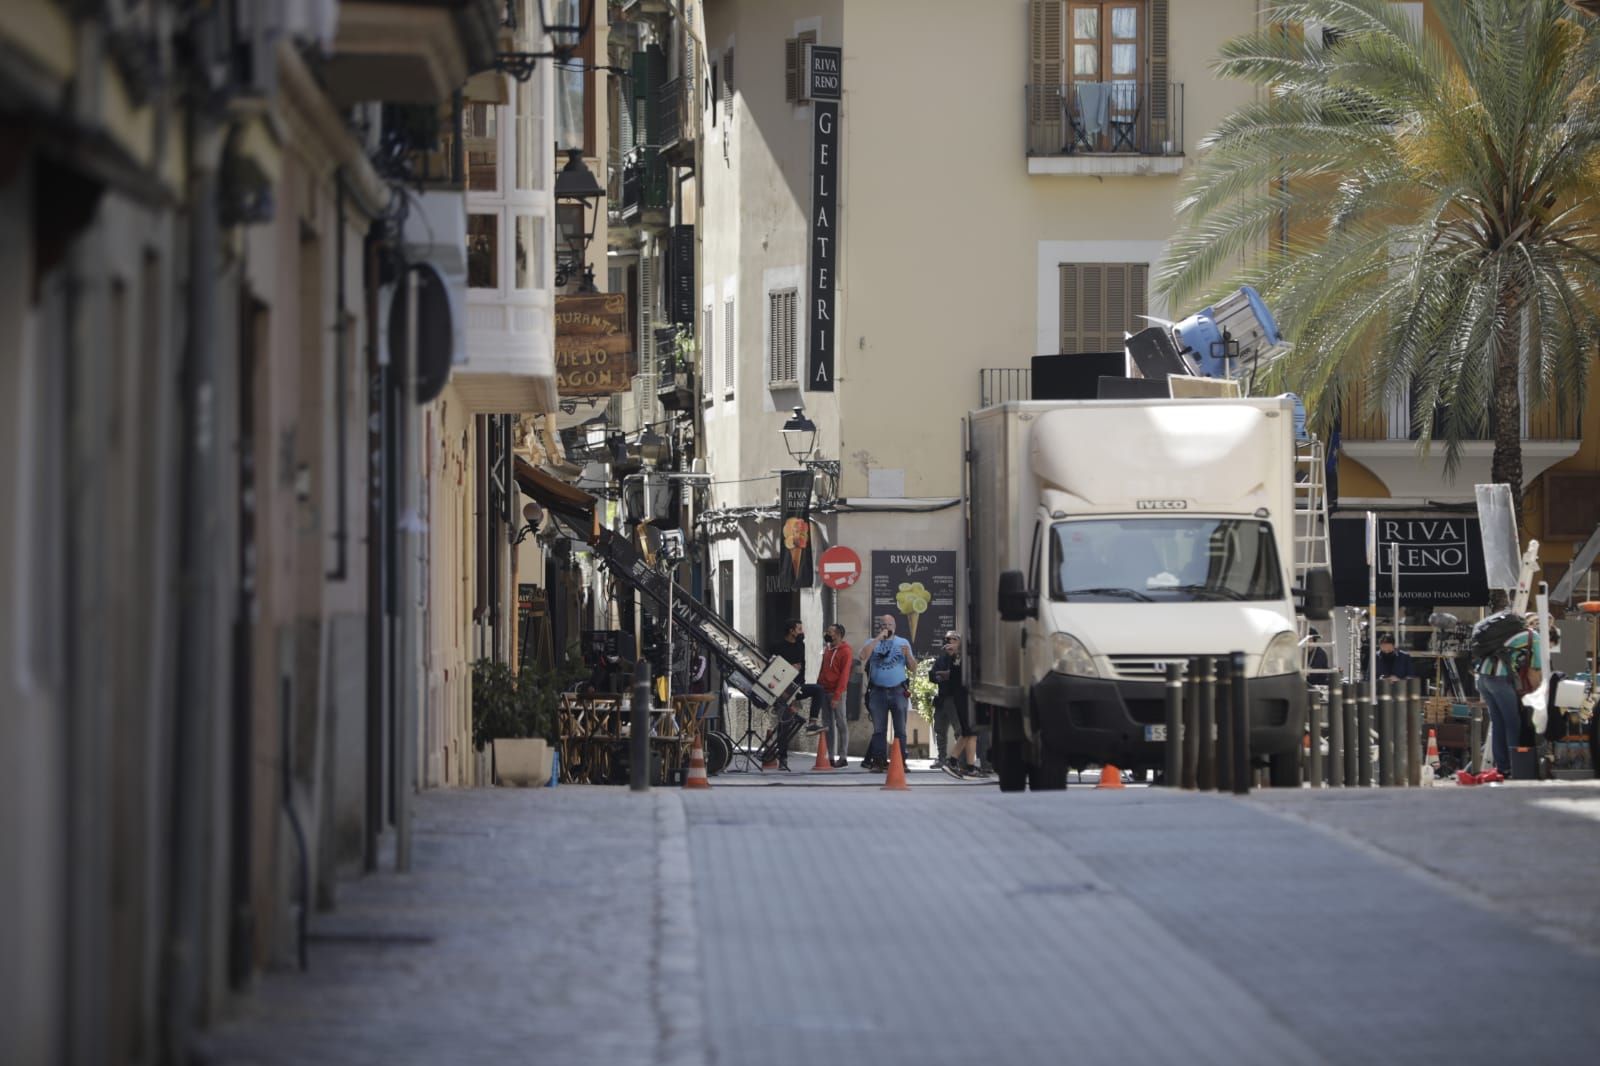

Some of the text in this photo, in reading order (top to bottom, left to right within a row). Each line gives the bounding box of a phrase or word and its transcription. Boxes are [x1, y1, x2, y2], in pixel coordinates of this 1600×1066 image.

[815, 58, 837, 71] RIVA
[815, 75, 838, 88] RENO
[816, 112, 832, 382] GELATERIA
[788, 491, 807, 499] RIVA
[1138, 500, 1186, 509] IVECO
[1385, 521, 1460, 540] RIVA
[890, 554, 937, 564] RIVARENO
